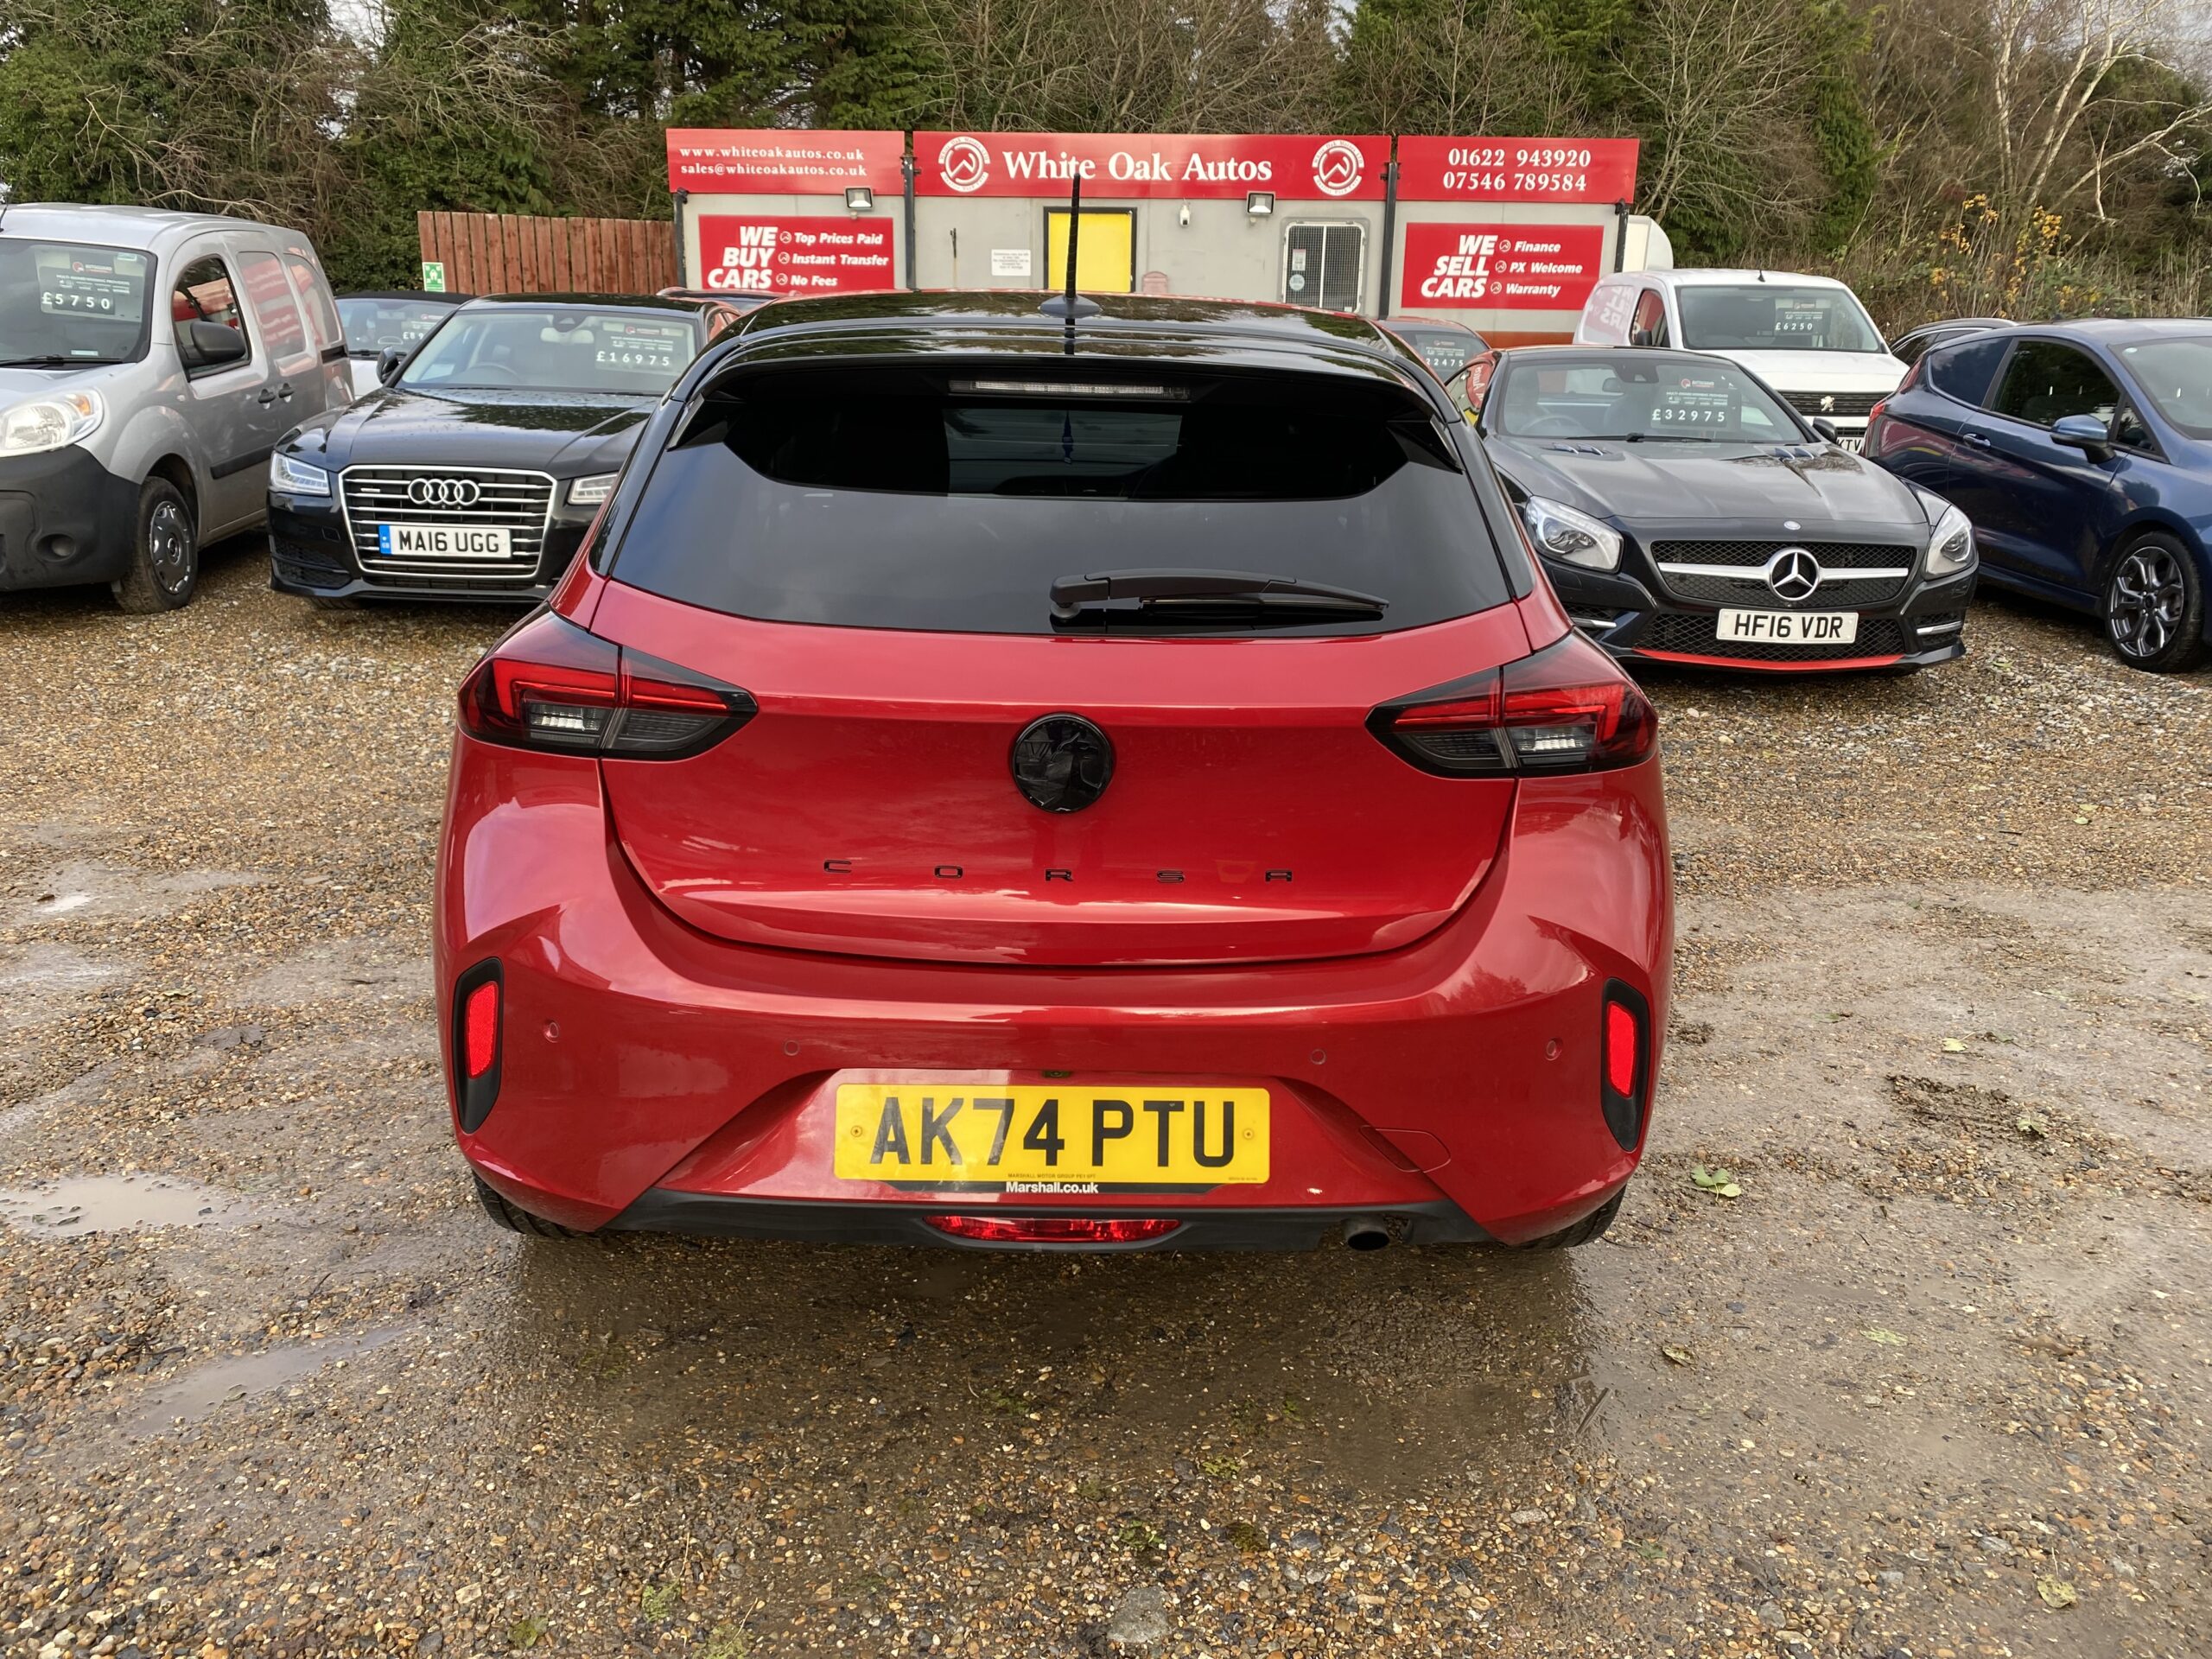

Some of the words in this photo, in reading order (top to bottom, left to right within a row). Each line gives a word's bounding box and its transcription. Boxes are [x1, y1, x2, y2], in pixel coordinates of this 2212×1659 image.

[679, 146, 864, 161] www.whiteoakautos.co.uk
[1448, 148, 1505, 167] 01622
[1516, 149, 1592, 168] 943920
[681, 162, 867, 176] sales@whiteoakautos.co.uk
[1001, 150, 1096, 180] White
[1108, 151, 1173, 181] Oak
[1181, 153, 1273, 181] Autos
[1443, 171, 1505, 190] 07546
[1514, 173, 1586, 191] 789584
[740, 226, 778, 247] WE
[794, 232, 817, 246] Top
[819, 233, 854, 245] Prices
[856, 233, 883, 245] Paid
[1459, 235, 1498, 255] WE
[1514, 241, 1561, 252] Finance
[722, 247, 776, 268] BUY
[791, 254, 836, 264] Instant
[840, 254, 889, 266] Transfer
[1433, 256, 1490, 276] SELL
[1510, 262, 1527, 273] PX
[1530, 263, 1583, 274] Welcome
[707, 268, 772, 289] CARS
[790, 276, 808, 286] No
[811, 276, 838, 286] Fees
[1421, 277, 1487, 298] CARS
[41, 291, 111, 309] £5750
[1506, 283, 1561, 298] Warranty
[1775, 322, 1813, 331] £6250
[596, 350, 670, 366] £16975
[1652, 409, 1725, 422] £32975
[399, 530, 448, 551] MA16
[455, 532, 499, 553] UGG
[1734, 613, 1792, 638] HF16
[1802, 616, 1843, 638] VDR
[823, 859, 1293, 883] CORSA
[869, 1096, 1065, 1166] AK74
[1092, 1100, 1234, 1167] PTU
[1006, 1181, 1099, 1193] Marshall.co.uk
